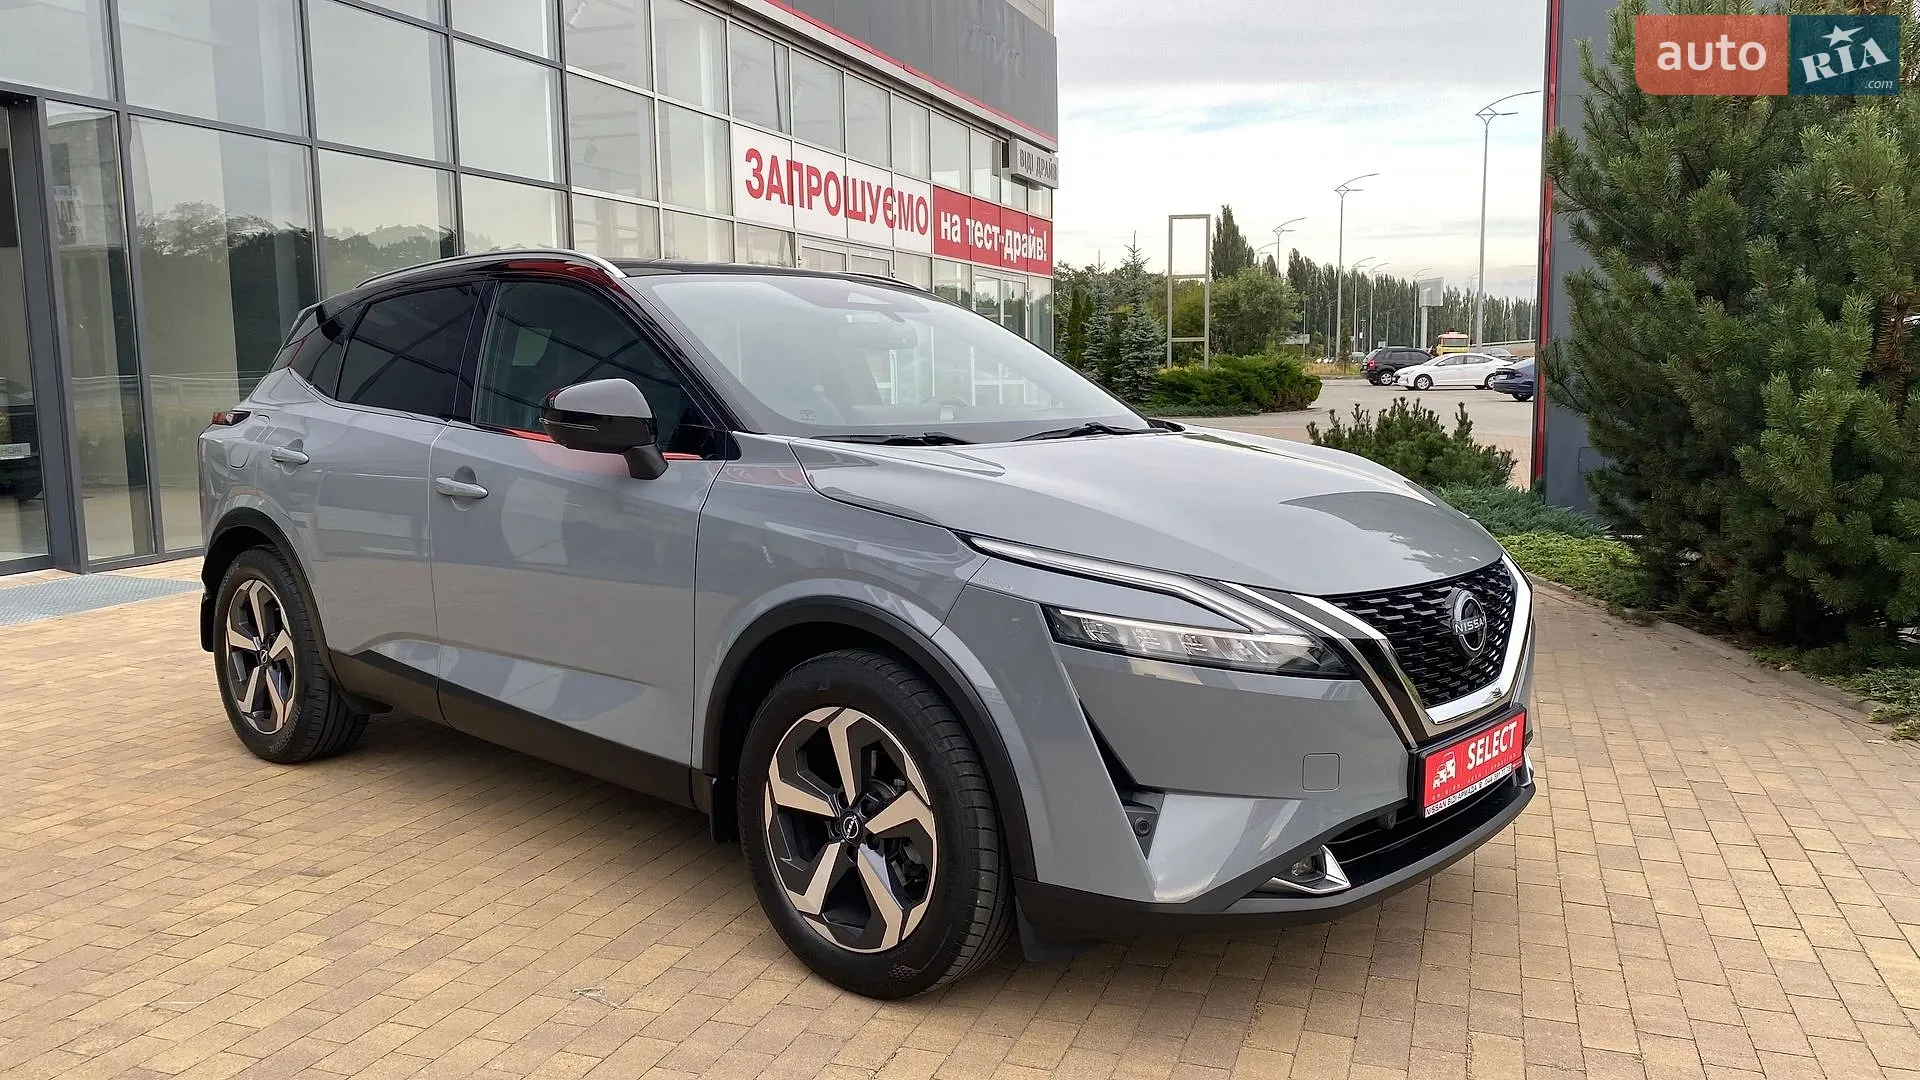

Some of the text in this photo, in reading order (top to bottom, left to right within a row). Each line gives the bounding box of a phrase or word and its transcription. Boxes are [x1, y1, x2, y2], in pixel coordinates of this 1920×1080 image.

[745, 147, 929, 236] ЗАПРОШУЄМО
[940, 211, 1048, 264] на тест-драйв!
[1466, 720, 1518, 771] SELECT
